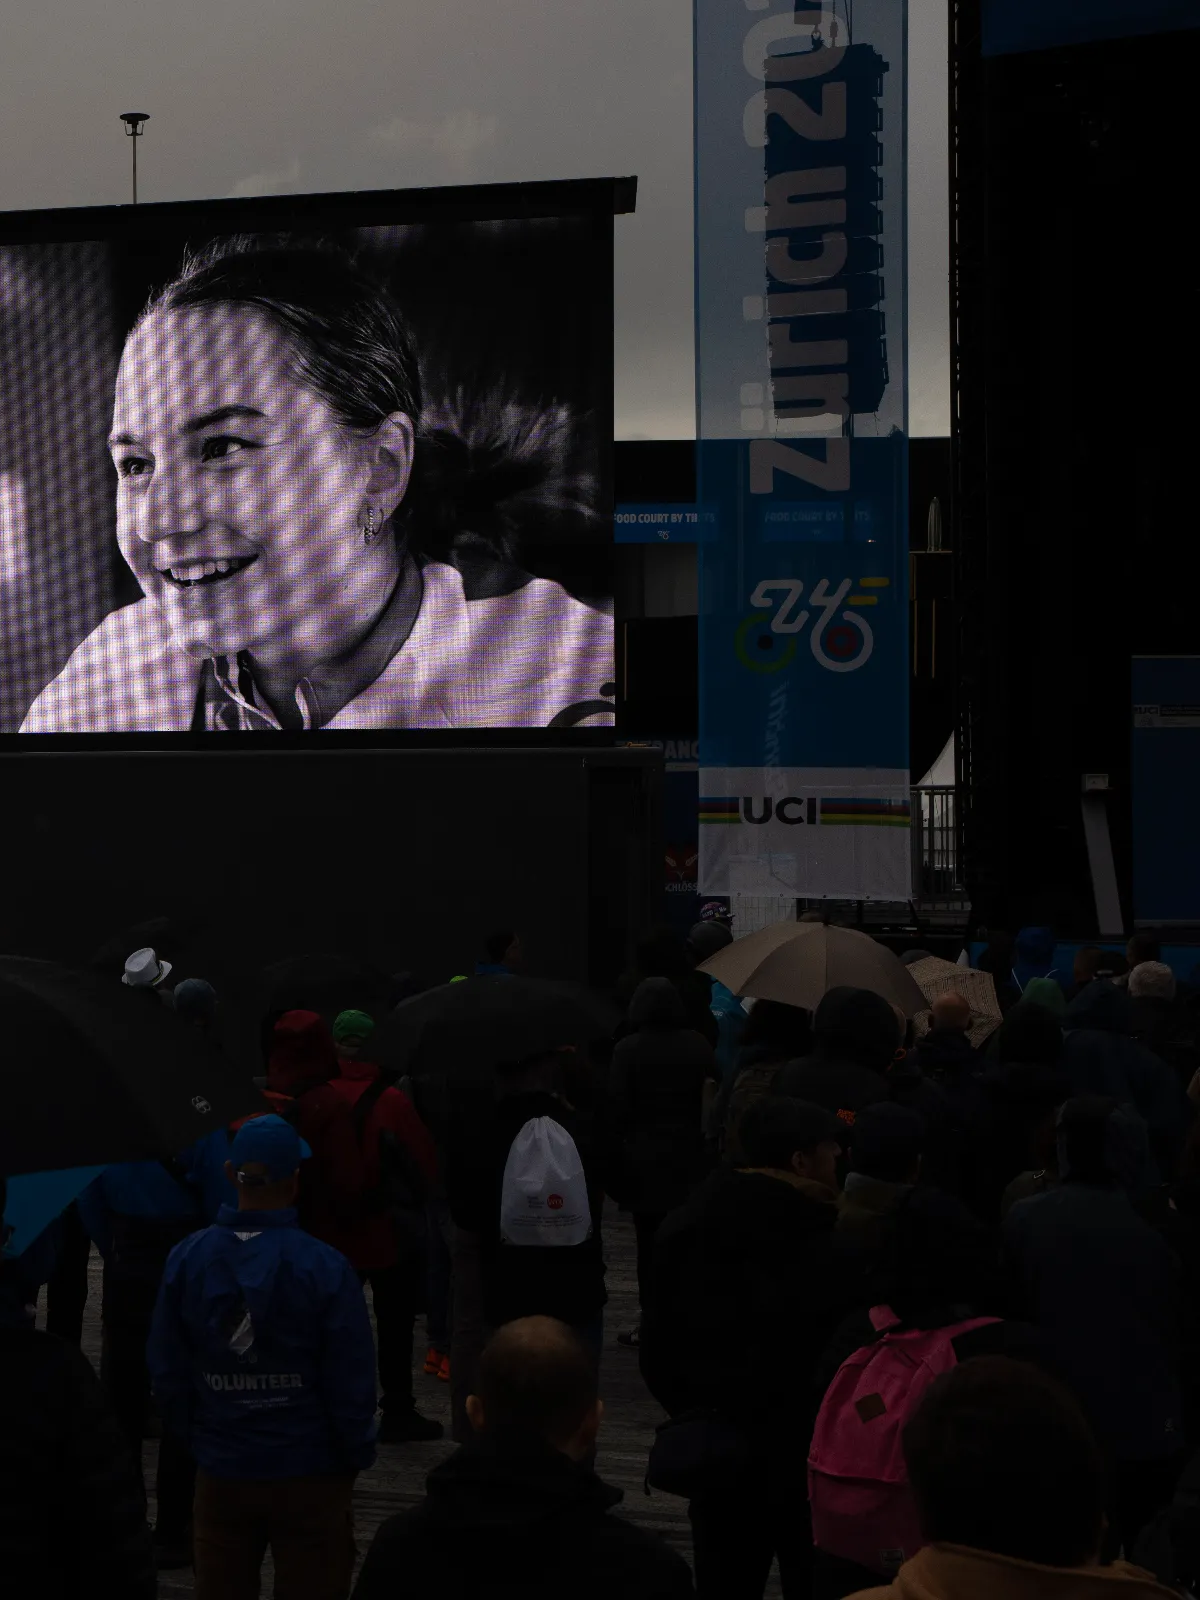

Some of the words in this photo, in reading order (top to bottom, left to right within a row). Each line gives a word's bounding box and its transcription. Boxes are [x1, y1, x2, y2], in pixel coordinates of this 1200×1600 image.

[637, 512, 669, 524] COURT
[670, 512, 683, 524] BY
[743, 796, 817, 825] UCI
[202, 1371, 305, 1392] VOLUNTEER
